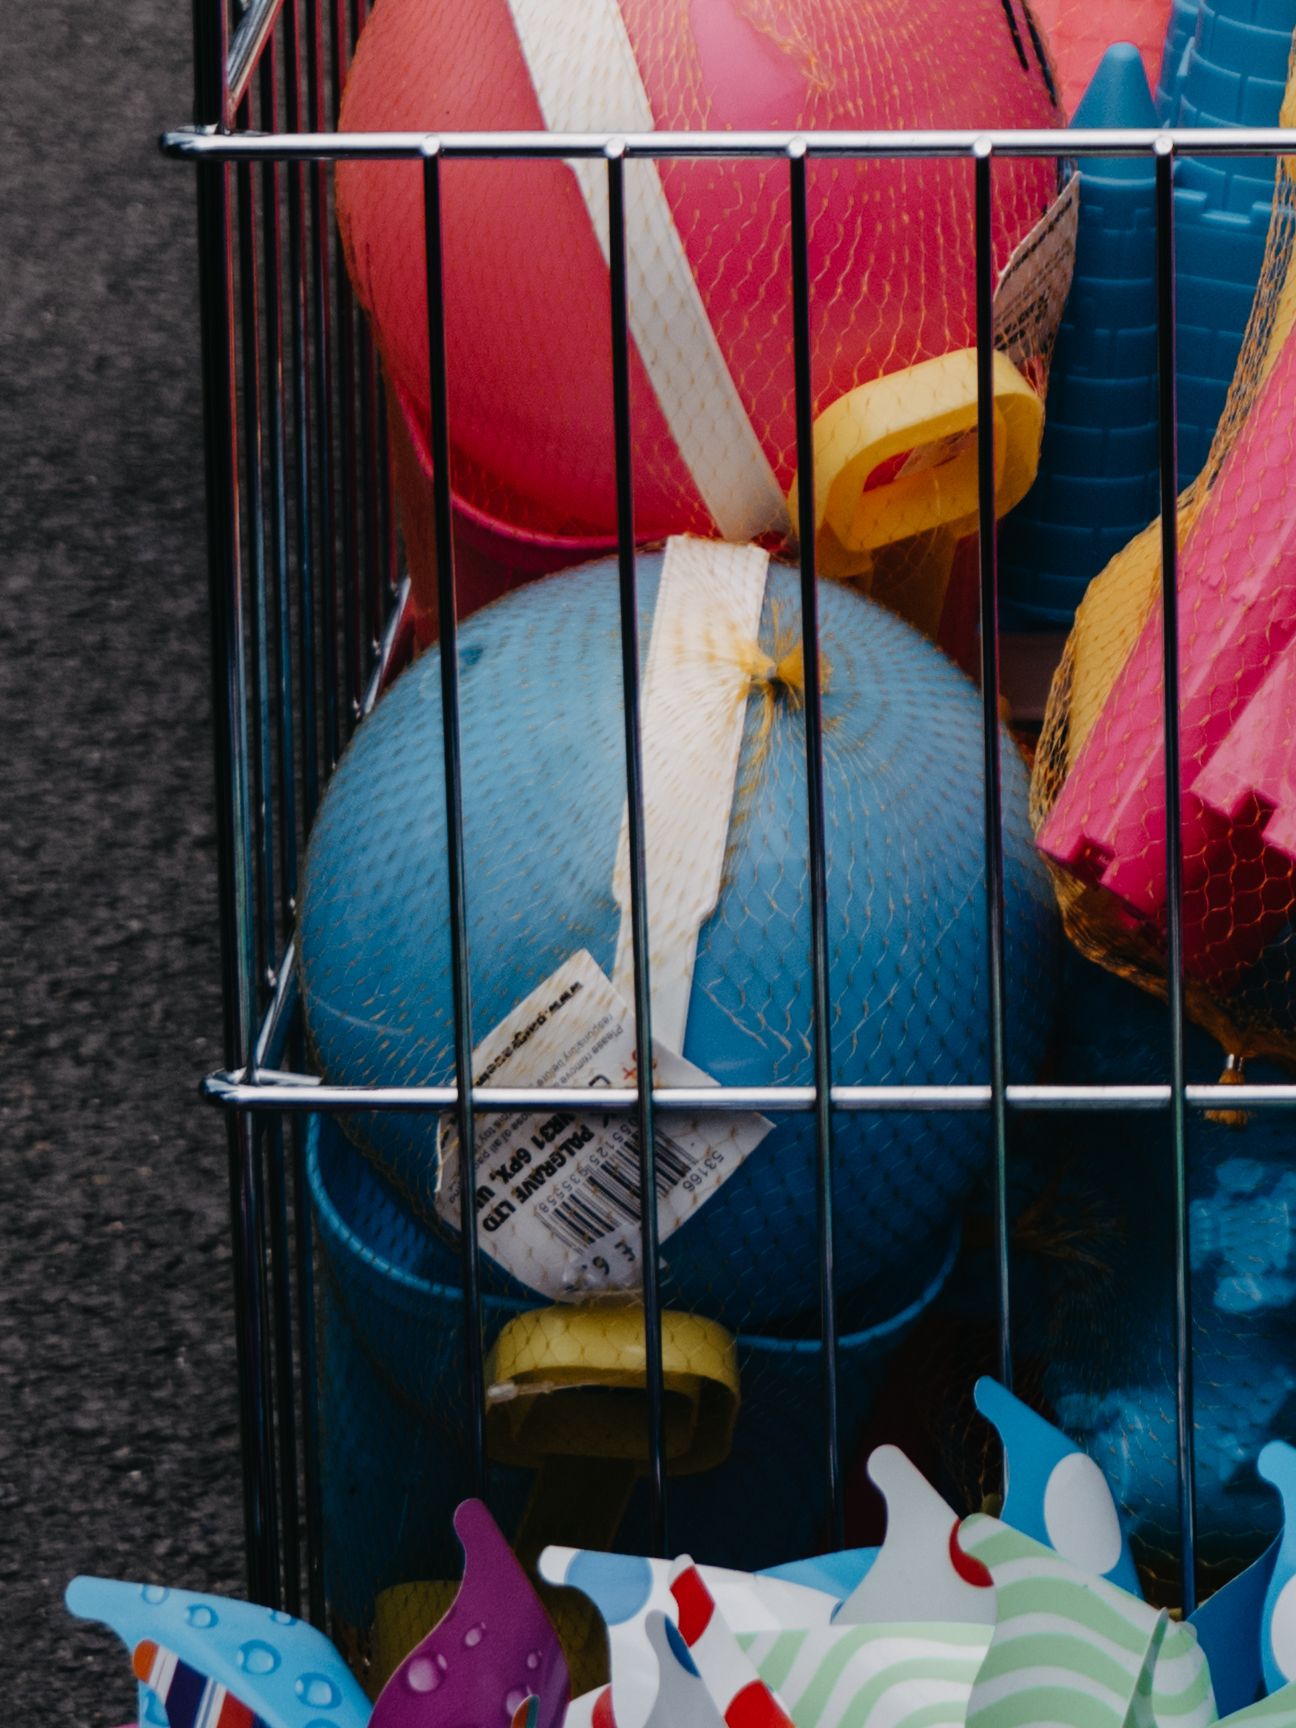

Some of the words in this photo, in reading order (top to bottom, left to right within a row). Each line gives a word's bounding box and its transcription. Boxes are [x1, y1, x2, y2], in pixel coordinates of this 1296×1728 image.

[512, 1124, 595, 1204] PALGRAVE
[682, 1150, 724, 1192] 53166
[482, 1199, 516, 1232] LTD
